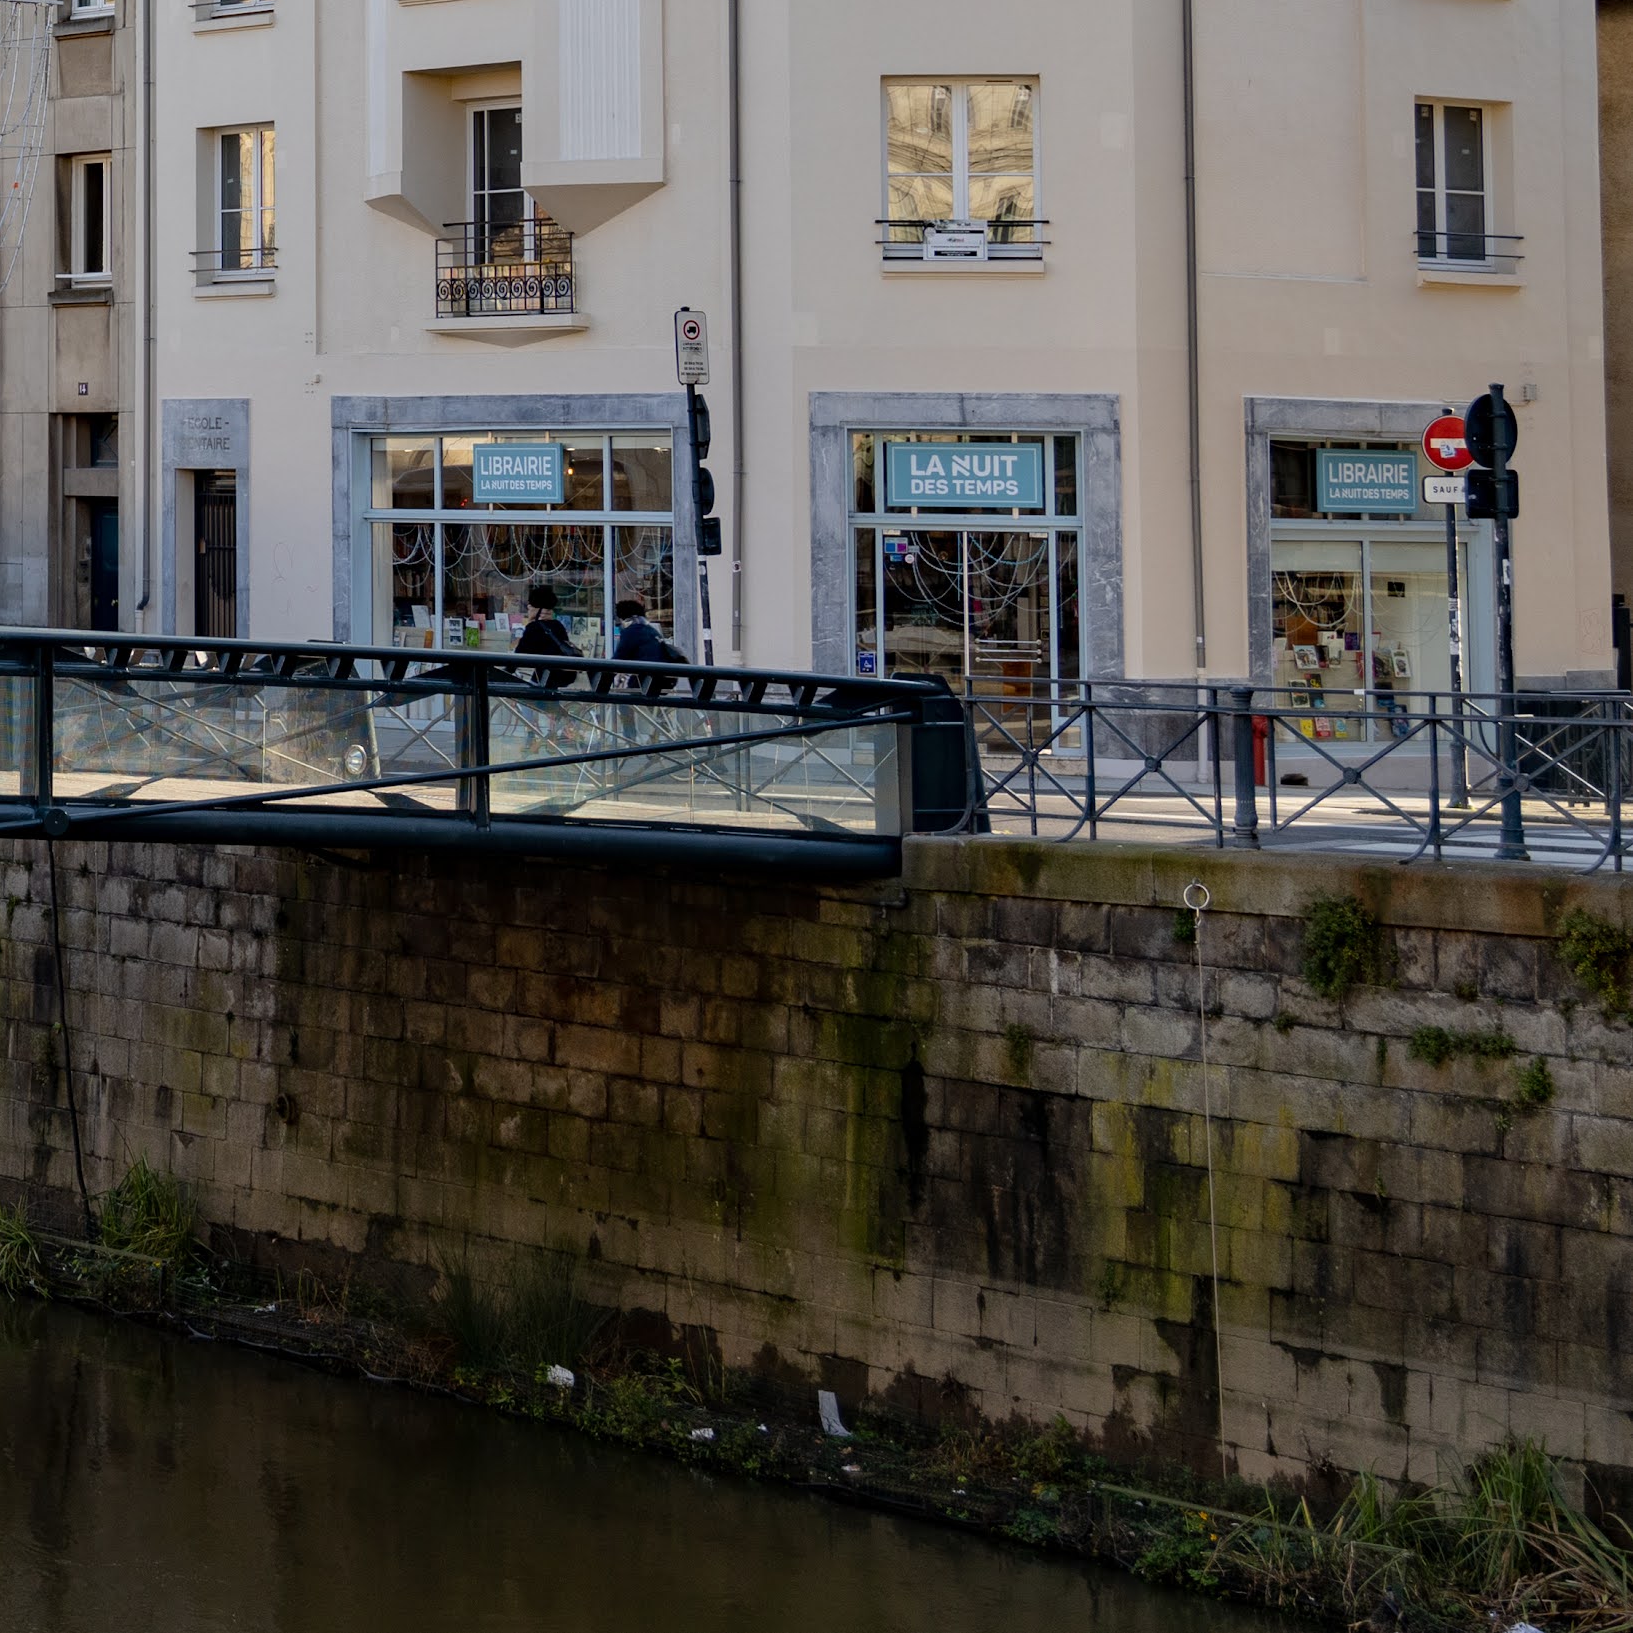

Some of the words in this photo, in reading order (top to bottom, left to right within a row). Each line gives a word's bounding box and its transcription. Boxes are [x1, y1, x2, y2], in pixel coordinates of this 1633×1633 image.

[187, 417, 222, 430] ECOLE
[480, 455, 552, 476] LIBRAIRIE
[910, 454, 945, 476] LA
[951, 454, 1018, 477] NUIT
[1328, 462, 1409, 484] LIBRAIRIE
[481, 480, 491, 490] LA
[492, 480, 509, 490] NUIT
[510, 480, 525, 490] DES
[525, 480, 553, 491] TEMPS
[911, 479, 949, 495] DES
[951, 479, 1019, 496] TEMPS
[1432, 485, 1459, 494] SAUF
[1329, 488, 1341, 498] LA
[1342, 488, 1362, 499] NUIT
[1363, 488, 1380, 499] DES
[1381, 489, 1409, 500] TEMPS
